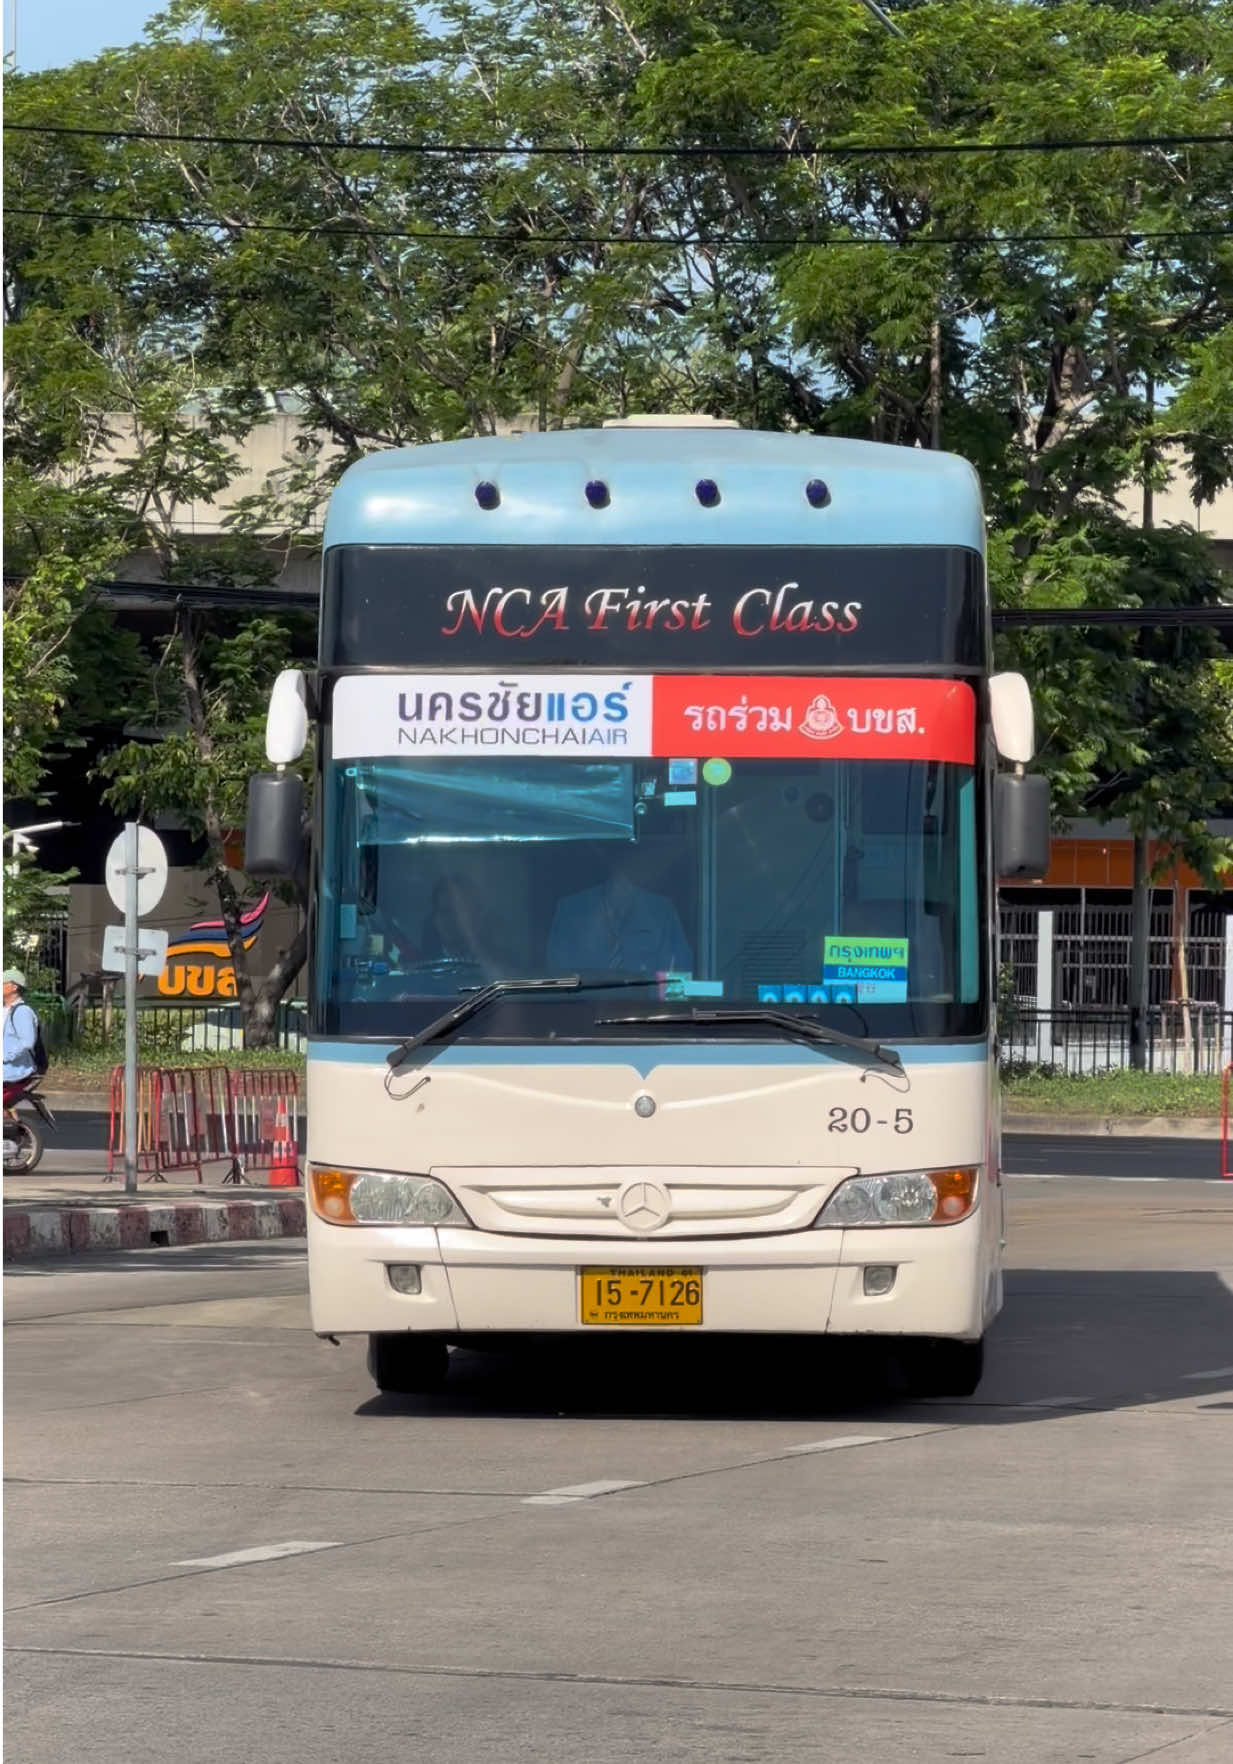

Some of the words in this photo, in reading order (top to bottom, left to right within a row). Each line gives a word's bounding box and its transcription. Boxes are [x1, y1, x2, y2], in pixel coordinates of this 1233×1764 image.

[441, 586, 569, 638] NCA
[584, 585, 711, 632] First
[732, 582, 862, 637] Class
[398, 681, 633, 723] นครชัยแอร์
[684, 695, 792, 732] รถร่วม
[847, 706, 925, 735] บขส.
[398, 727, 628, 745] NAKHONCHAIAIR
[830, 944, 904, 962] กรุงเทพฯ
[838, 967, 895, 979] BANGKOK
[828, 1107, 914, 1134] 20-5
[596, 1280, 700, 1306] 15-7126
